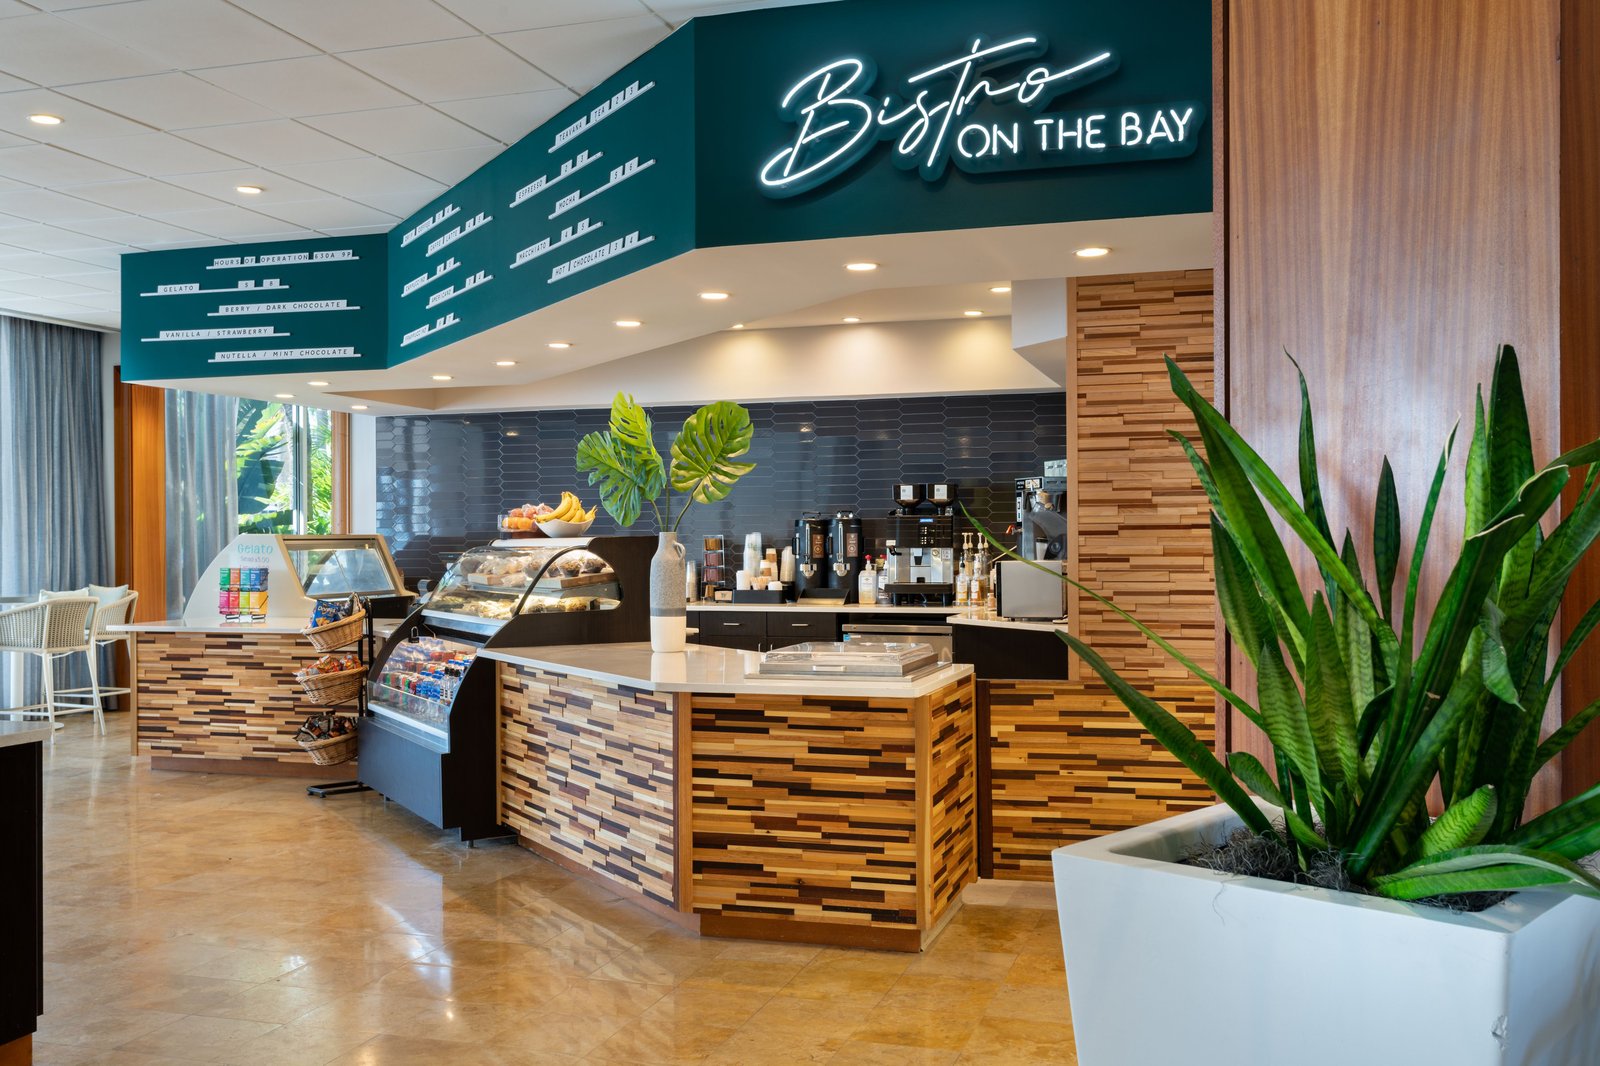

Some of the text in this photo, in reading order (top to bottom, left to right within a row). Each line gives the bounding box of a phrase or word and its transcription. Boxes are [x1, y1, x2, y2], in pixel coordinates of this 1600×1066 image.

[760, 37, 1111, 186] Bistro
[559, 121, 582, 141] TEAVANA
[594, 106, 605, 118] TEA
[957, 107, 1193, 158] ON THE BAY
[518, 179, 543, 199] ESPRESSO
[559, 195, 576, 209] MOCHA
[260, 254, 308, 263] OPERATION
[518, 242, 546, 260] MACCHIATO
[555, 266, 566, 275] HOT
[573, 248, 605, 268] CHOCOLATE
[292, 301, 341, 310] CHOCOLATE
[217, 328, 268, 336] STRAWBERRY
[299, 348, 348, 356] CHOCOLATE
[237, 543, 274, 554] Gelato
